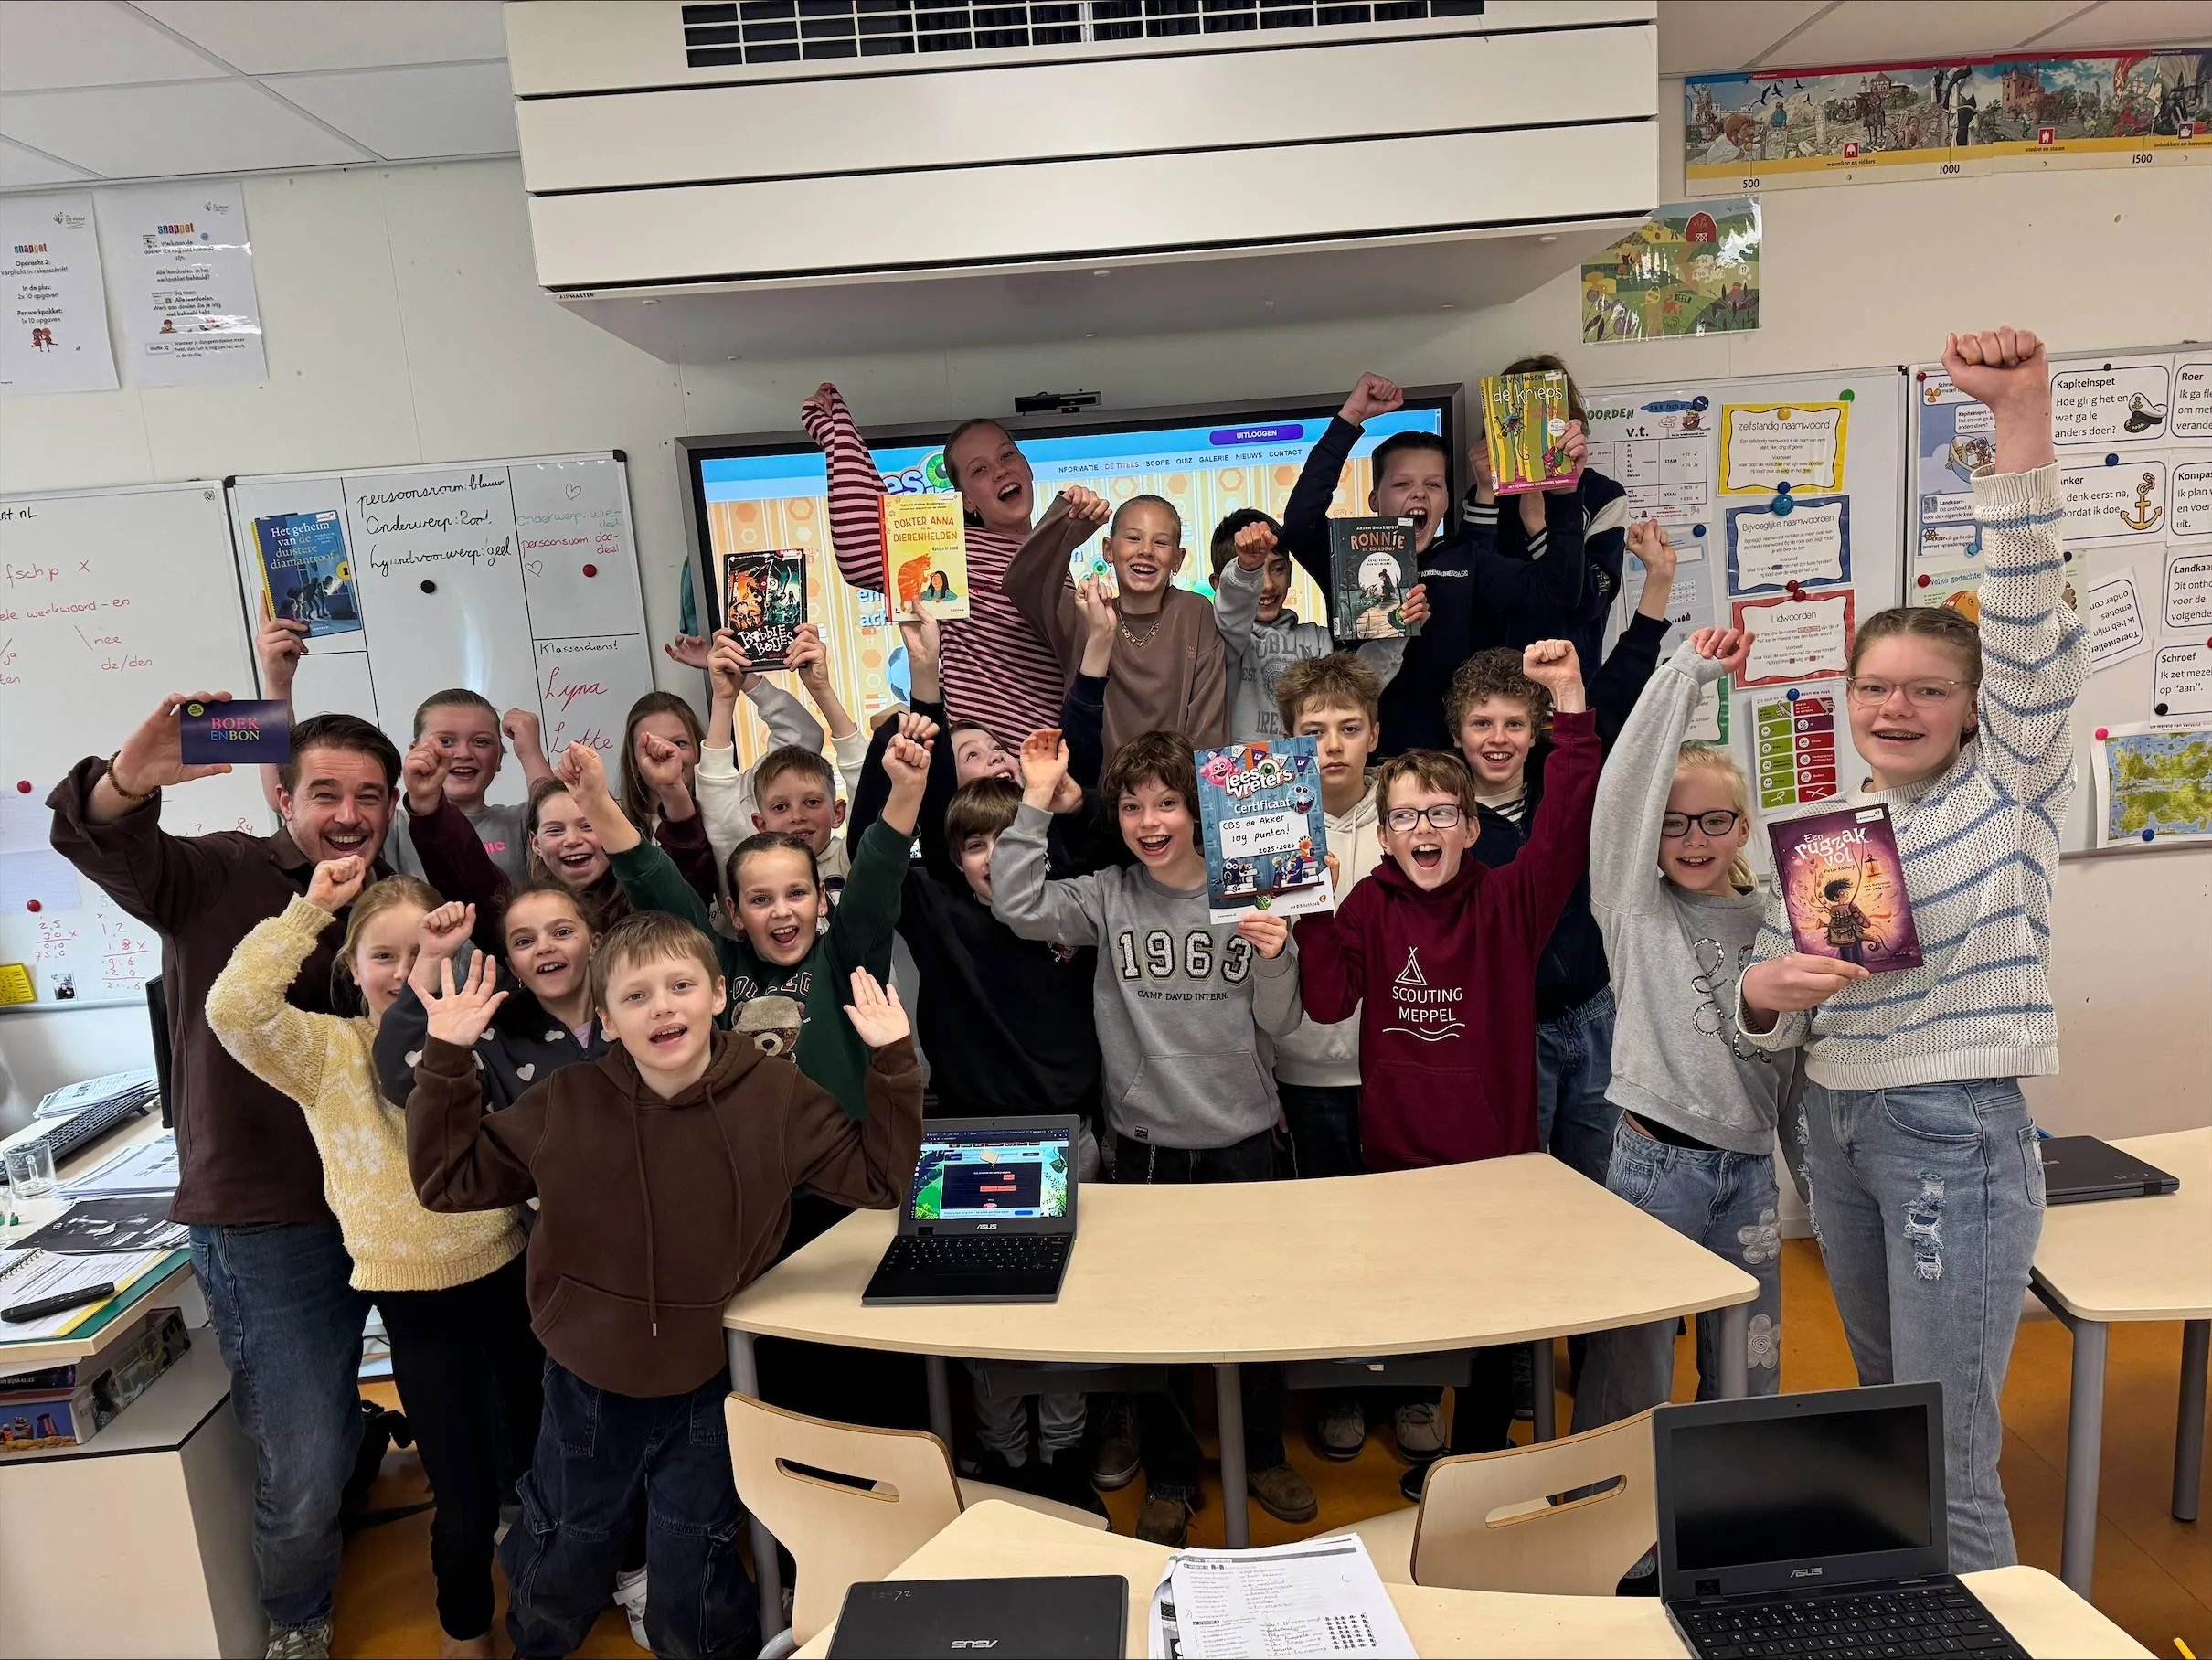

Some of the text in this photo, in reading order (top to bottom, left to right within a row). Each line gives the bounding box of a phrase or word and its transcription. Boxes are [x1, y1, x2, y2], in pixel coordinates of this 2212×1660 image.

[2133, 154, 2152, 164] 1500
[1940, 165, 1960, 175] 1000
[1743, 179, 1759, 188] 500
[2057, 378, 2115, 389] Kapiteinspet
[1494, 387, 1563, 405] de krieps
[2190, 390, 2201, 399] ga
[2056, 398, 2075, 406] Hoe
[2078, 397, 2097, 407] ging
[2100, 395, 2114, 403] het
[1587, 409, 1634, 420] OORDEN
[2056, 412, 2097, 423] wat ga je
[1781, 420, 1830, 430] naamwoord
[1236, 430, 1277, 439] UITLOGGEN
[1627, 427, 1649, 437] v.t.
[2055, 426, 2116, 438] anders doen?
[1057, 464, 1099, 474] INFORMATIE
[1269, 449, 1302, 457] CONTACT
[2061, 476, 2084, 485] nker
[2067, 490, 2129, 502] denk eerst na,
[2188, 488, 2207, 499] plan
[2062, 507, 2091, 517] oordat
[2093, 505, 2102, 515] ik
[2177, 505, 2188, 513] en
[894, 517, 927, 529] DOKTER
[931, 516, 954, 526] ANNA
[1783, 515, 1834, 527] naamwoorden
[2176, 520, 2191, 528] uit.
[271, 522, 329, 537] Het geheim
[278, 537, 296, 547] van
[299, 535, 311, 543] de
[893, 531, 958, 542] DIERENHELDEN
[276, 546, 317, 558] duistere
[271, 551, 336, 569] diamantroof
[2175, 564, 2212, 574] Landkaa
[2173, 582, 2186, 591] Dit
[2172, 595, 2206, 605] voor de
[27, 601, 96, 620] werkwoord
[2100, 603, 2132, 621] emoties
[1771, 612, 1816, 623] Lidwoorden
[2171, 612, 2212, 621] volgende
[2111, 620, 2125, 631] heb
[93, 634, 122, 644] nee
[1256, 633, 1312, 659] UBLN
[2162, 653, 2196, 664] Schroef
[2161, 670, 2169, 679] Ik
[2187, 668, 2212, 678] mezel
[2159, 686, 2171, 695] op
[212, 718, 261, 729] BOEK
[210, 730, 259, 740] ENBON
[551, 722, 613, 753] Ltte
[1234, 800, 1292, 814] Certificaat
[1223, 822, 1240, 830] CBS
[1260, 815, 1284, 825] Akker
[1794, 827, 1872, 860] rugzak
[1804, 833, 1824, 843] Een
[1824, 848, 1854, 867] vol
[1117, 929, 1253, 987] 1963
[1137, 990, 1228, 1002] CAMP DAVID INTERN.
[1392, 986, 1462, 1004] SCOUTING
[1398, 1006, 1457, 1023] MEPPEL
[1789, 1568, 1823, 1578] ASUS
[951, 1639, 998, 1649] ASUS
